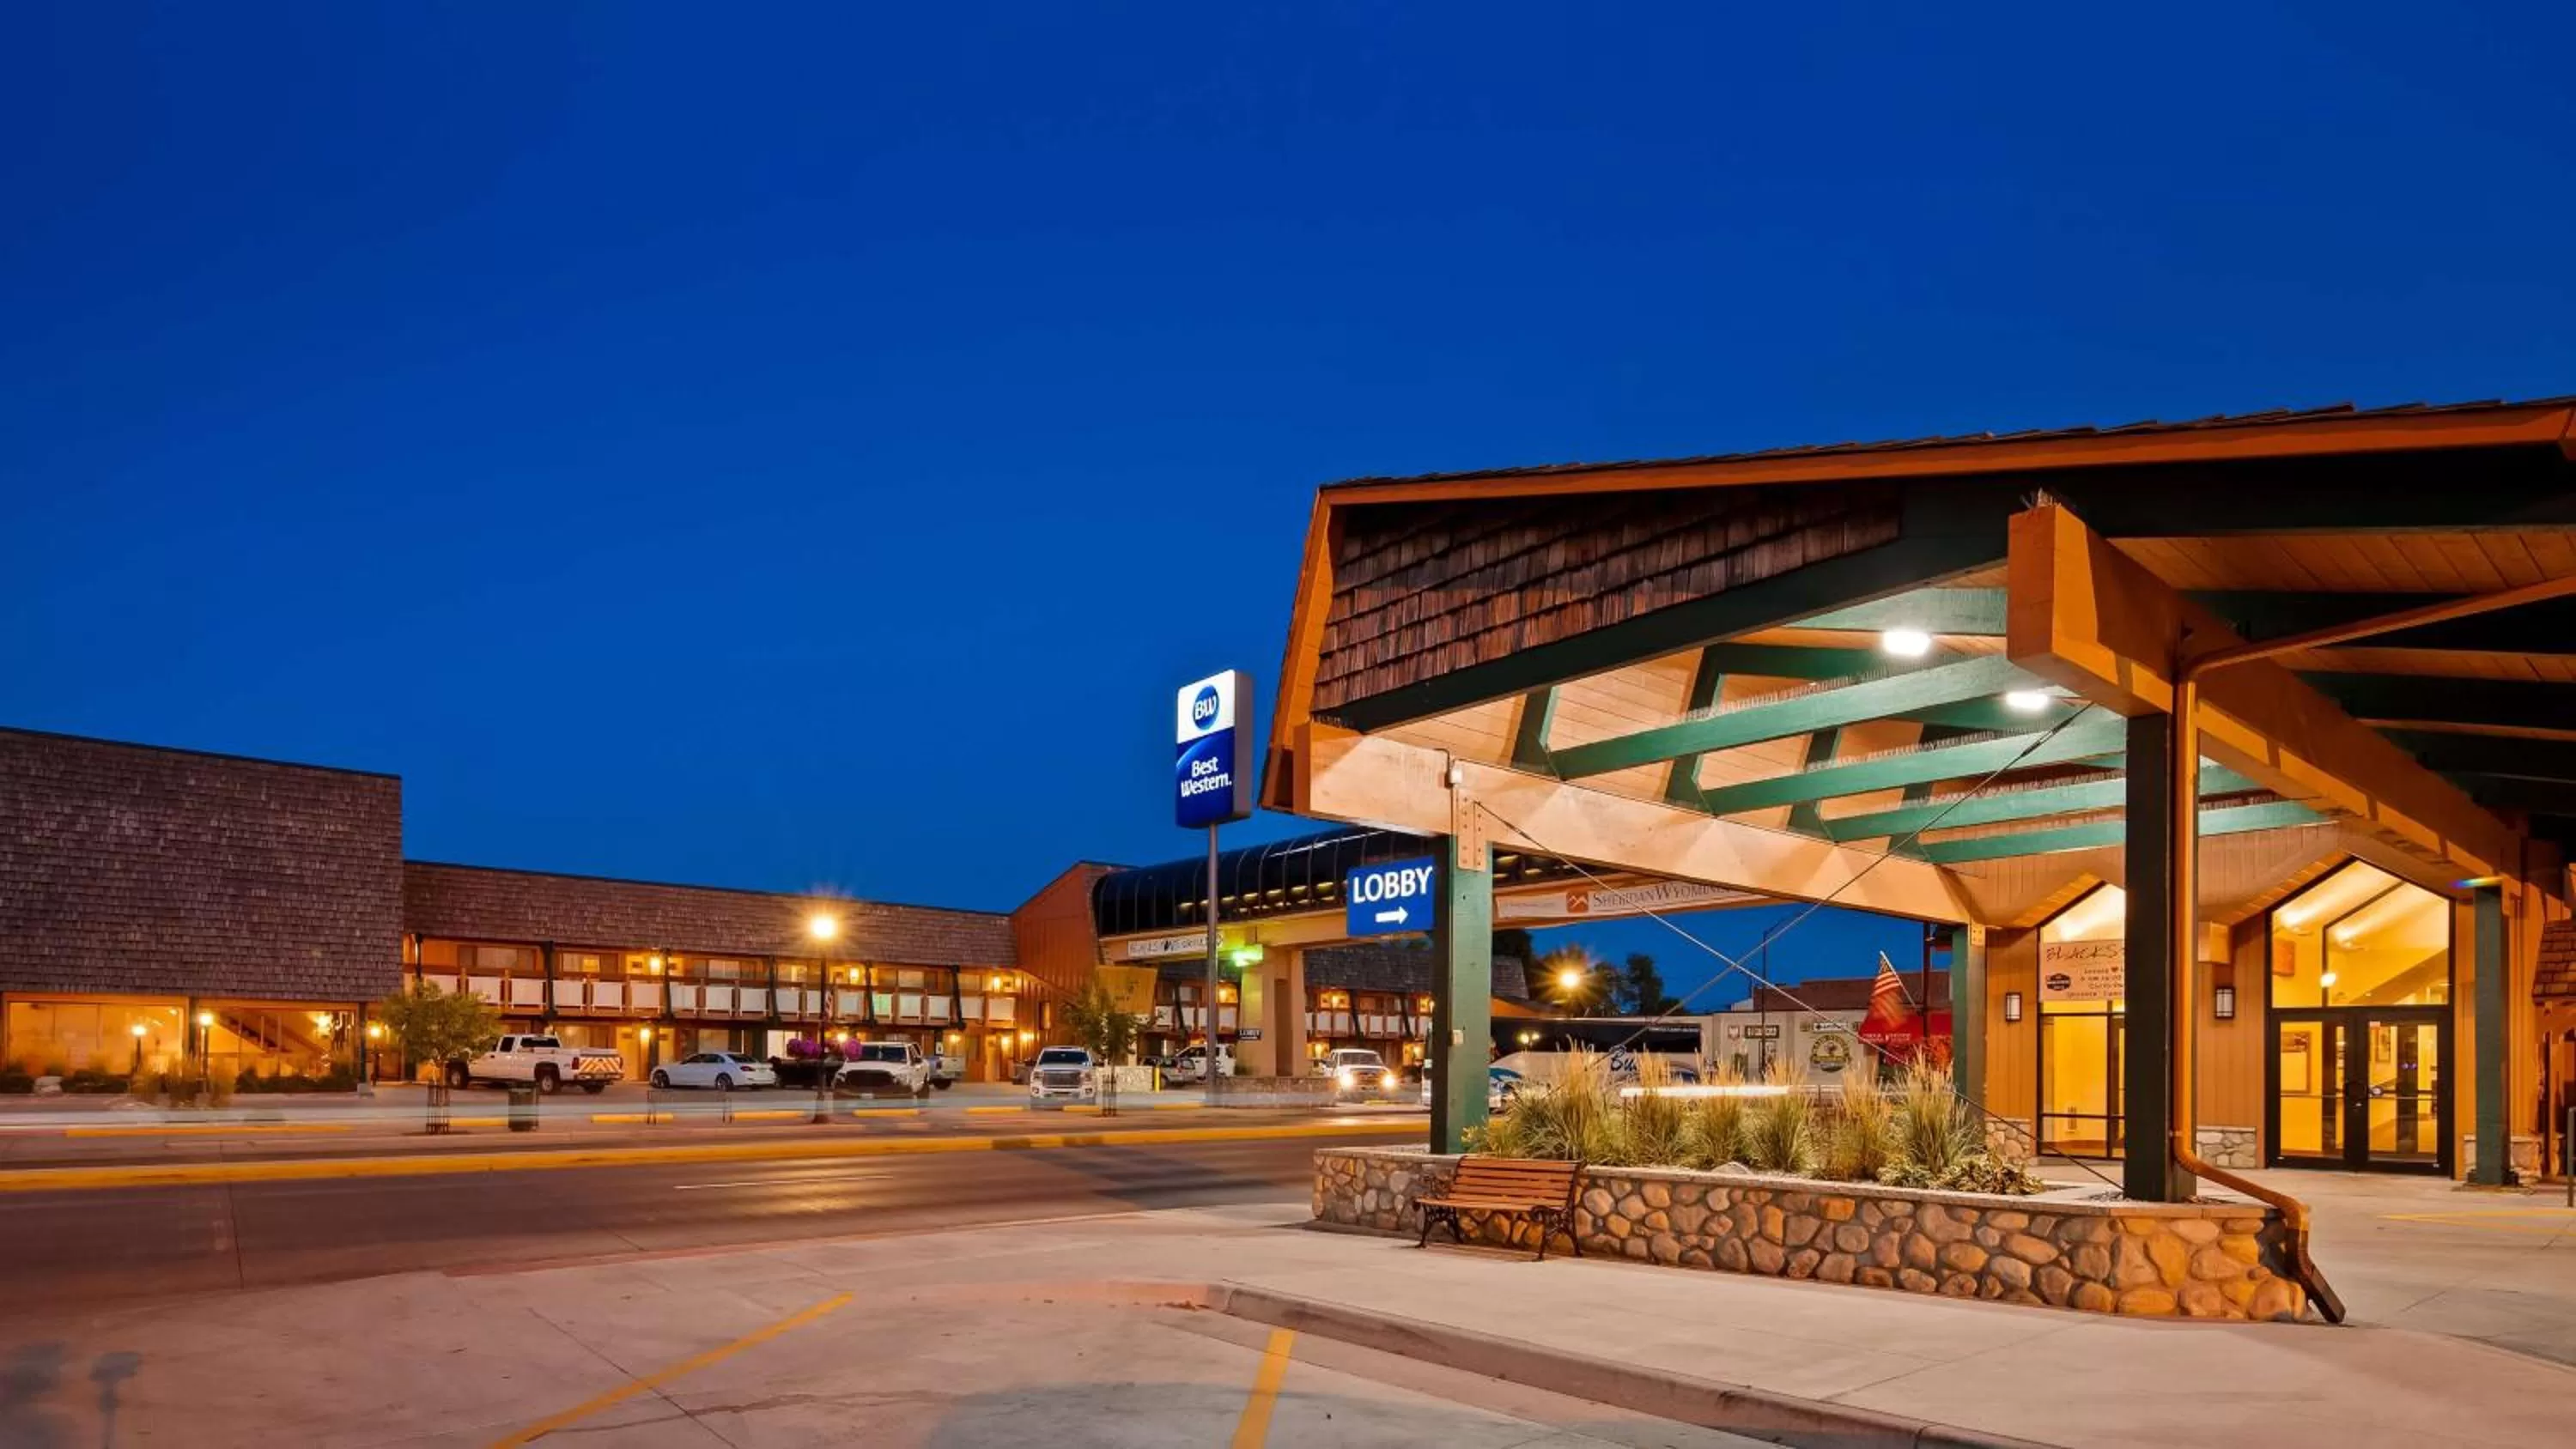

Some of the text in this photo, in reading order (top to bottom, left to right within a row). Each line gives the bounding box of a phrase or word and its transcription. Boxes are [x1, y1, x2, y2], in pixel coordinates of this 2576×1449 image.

[1194, 695, 1217, 721] BW
[1191, 756, 1219, 778] Best
[1353, 865, 1433, 904] LOBBY
